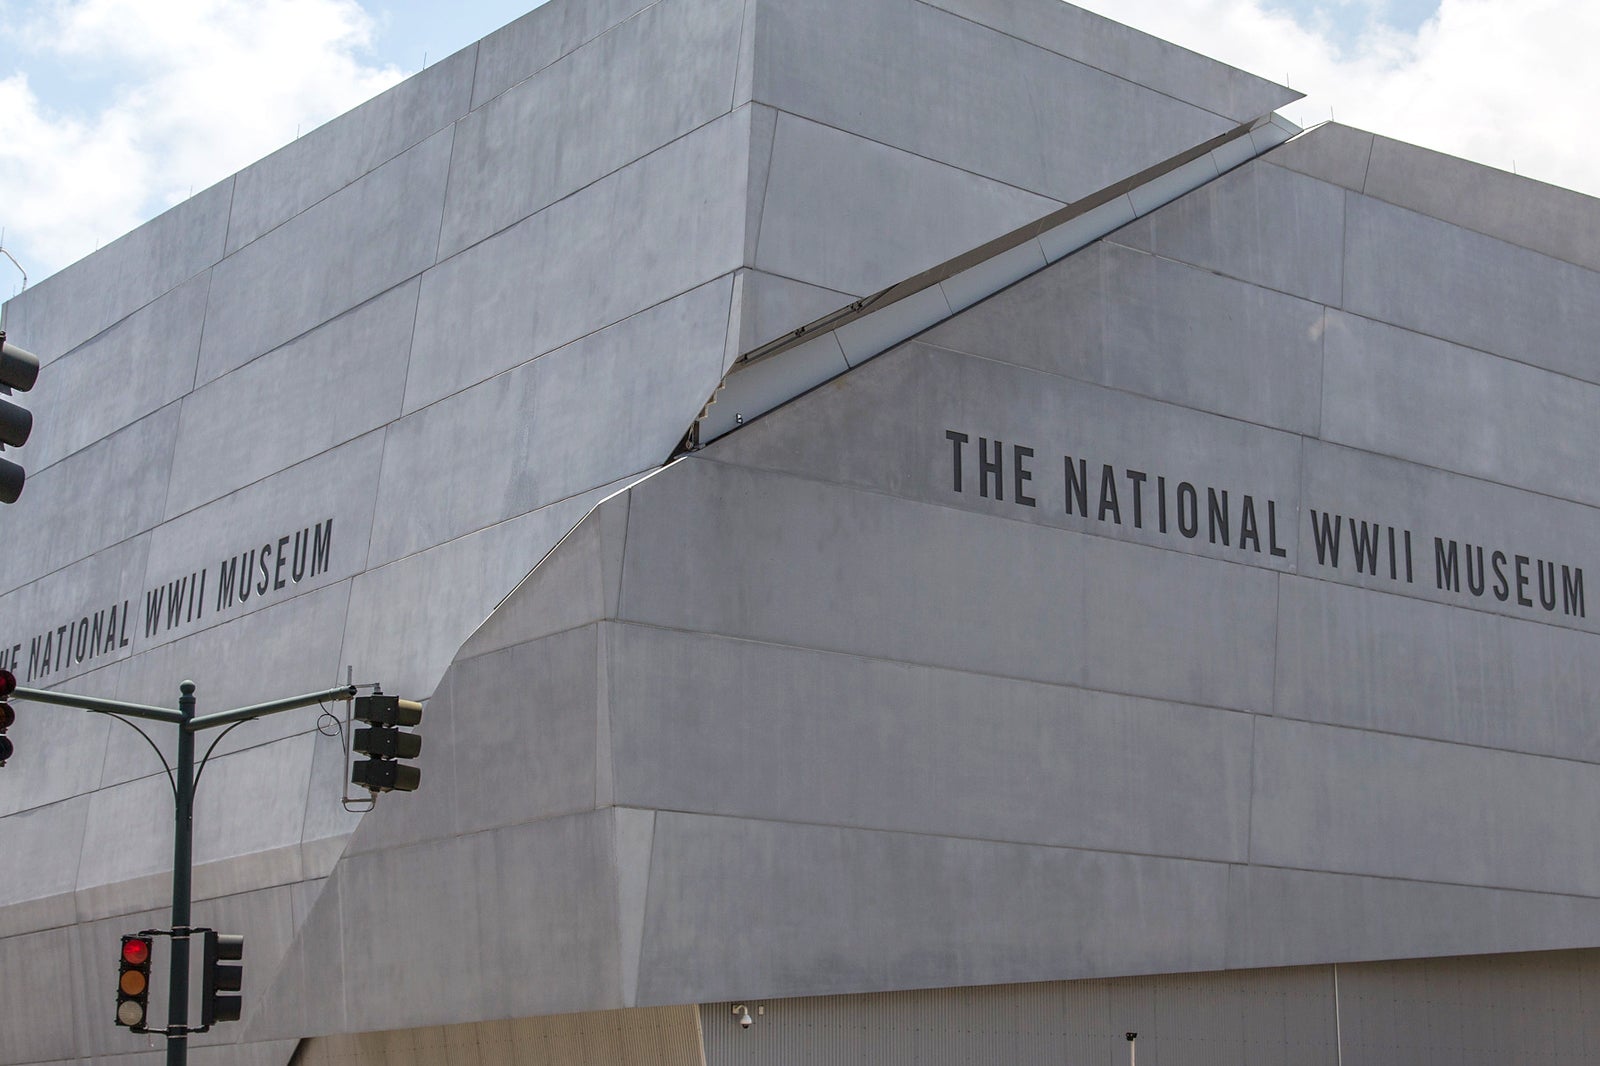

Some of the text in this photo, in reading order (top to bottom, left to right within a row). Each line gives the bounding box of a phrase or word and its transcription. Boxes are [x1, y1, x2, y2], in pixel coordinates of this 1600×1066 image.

[27, 600, 129, 682] NATIONAL
[145, 568, 207, 638] WWII
[216, 518, 333, 612] MUSEUM
[945, 429, 1586, 618] THE NATIONAL WWII MUSEUM
